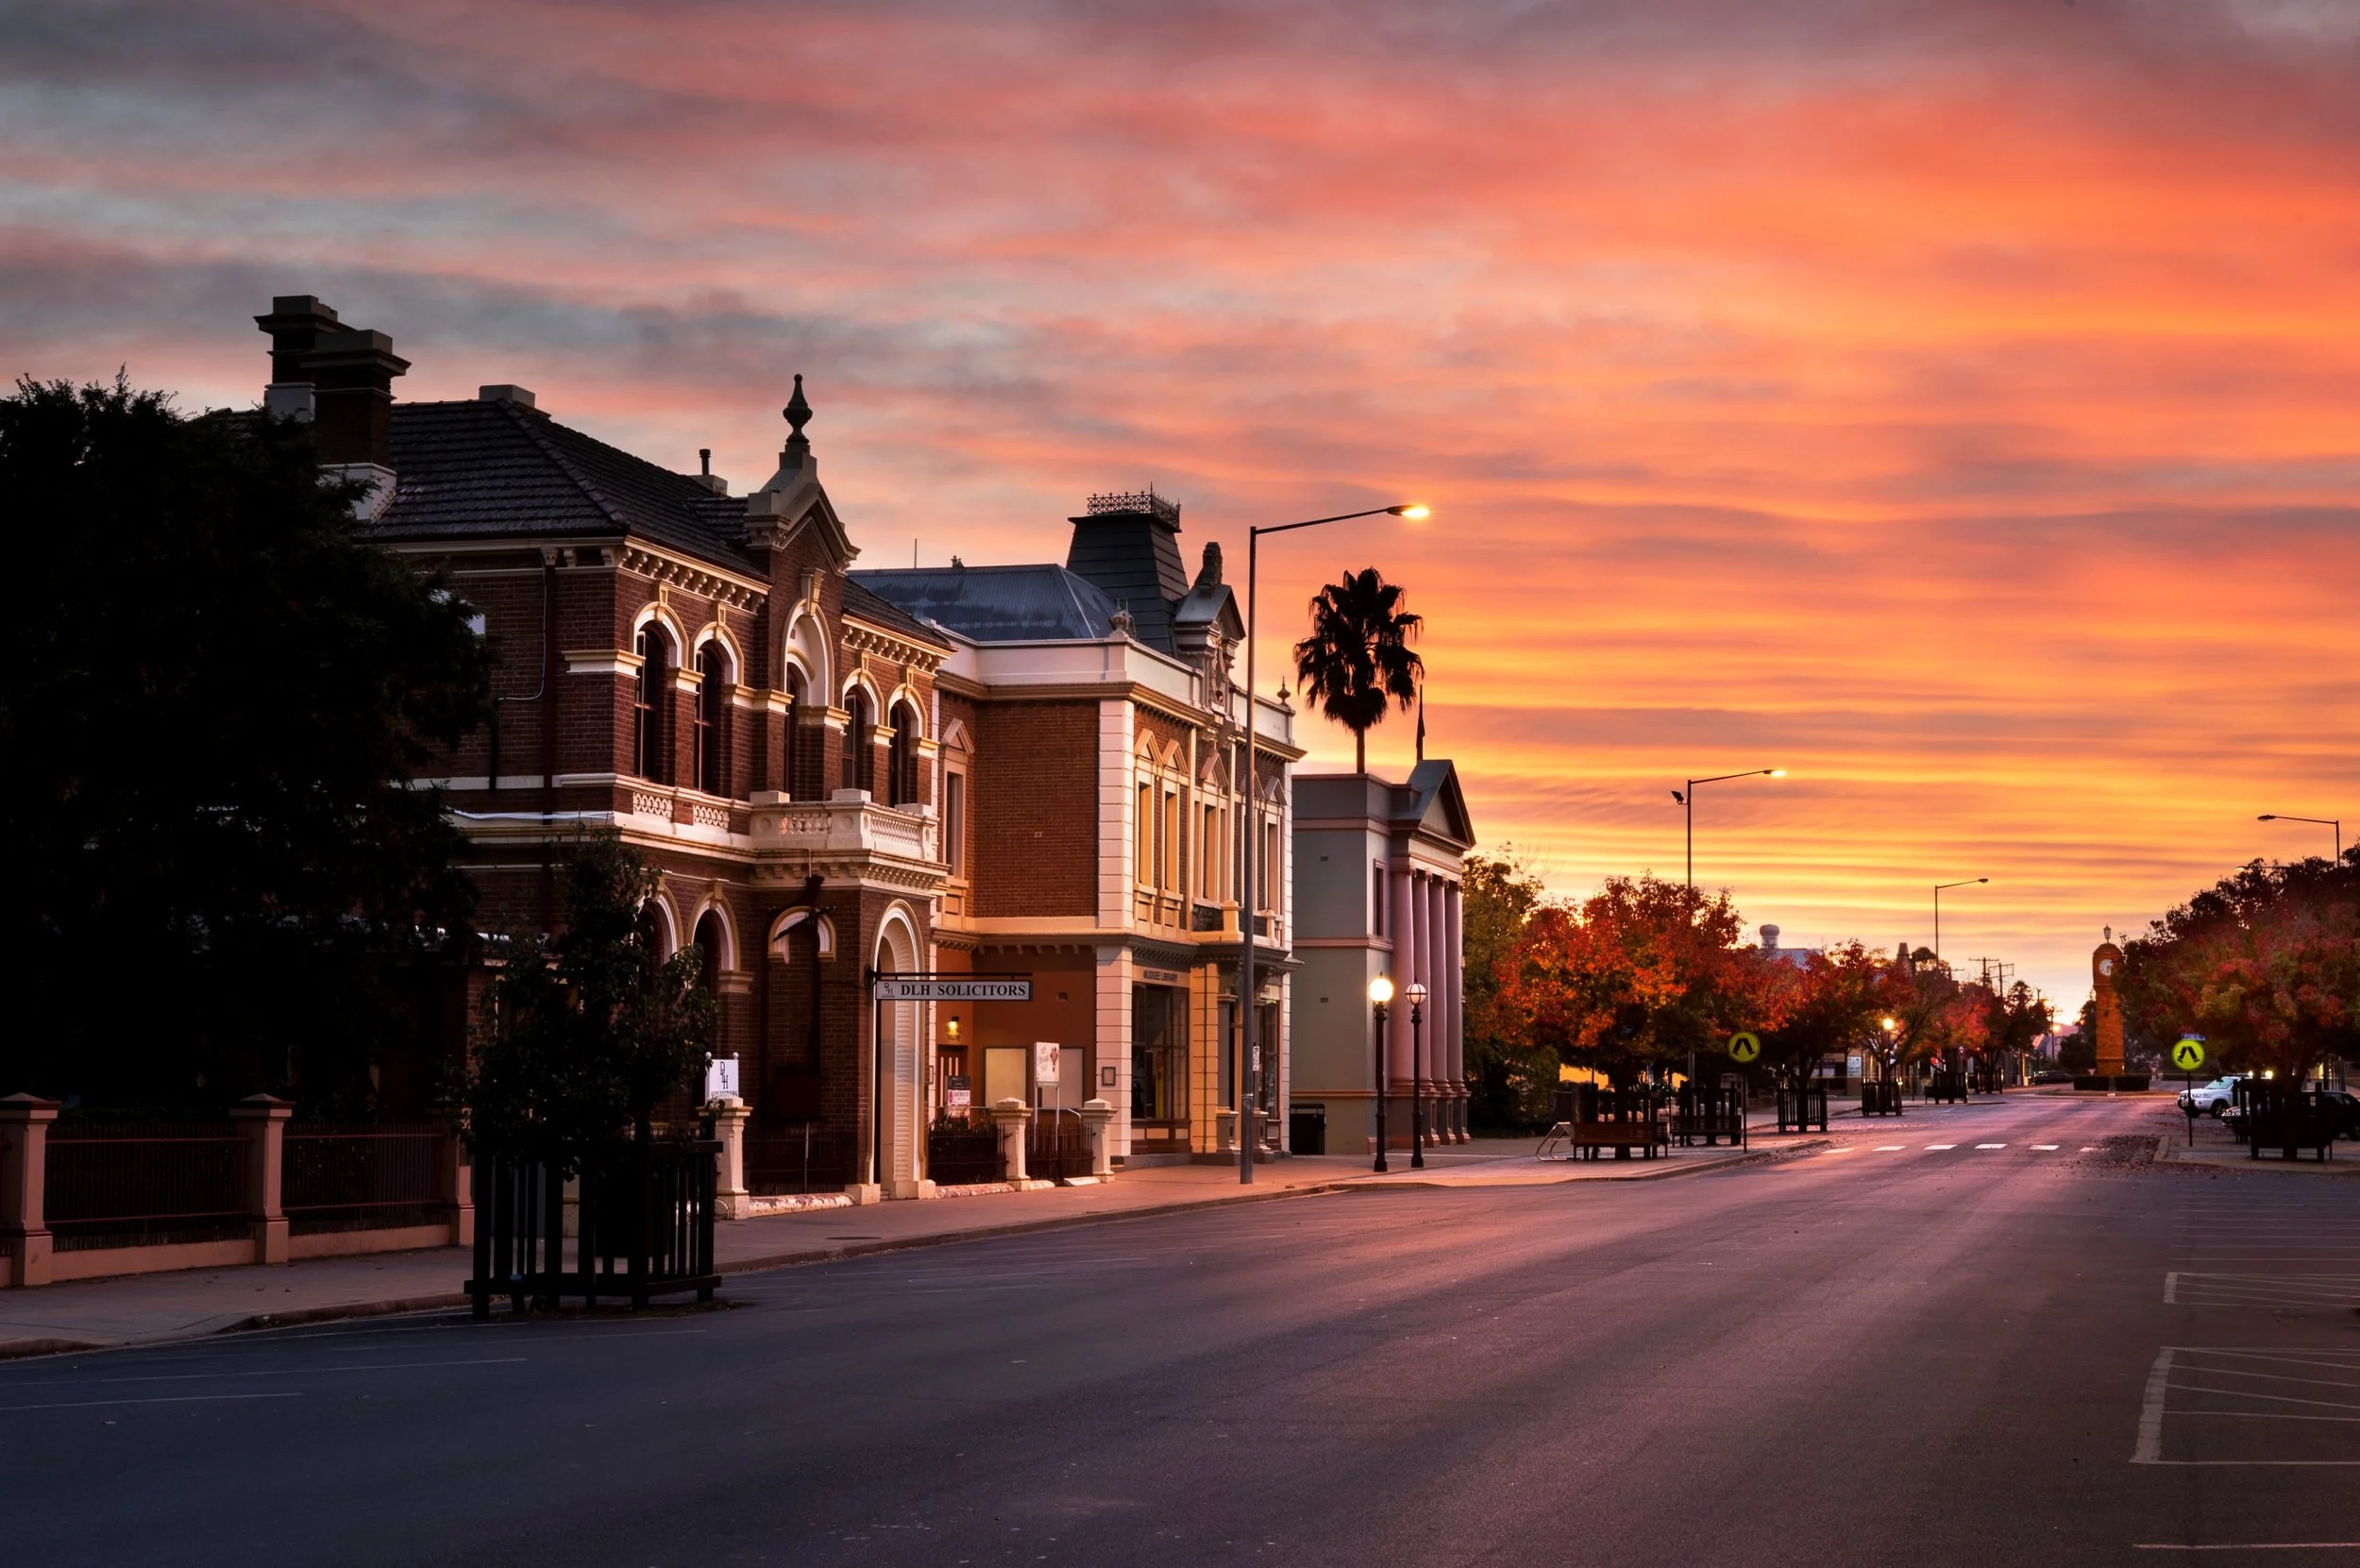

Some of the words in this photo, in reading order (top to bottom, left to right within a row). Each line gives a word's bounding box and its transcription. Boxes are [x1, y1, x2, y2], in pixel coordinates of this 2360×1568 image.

[1161, 971, 1178, 983] LIBRARY
[901, 984, 930, 996] DLH
[936, 984, 1026, 996] SOLICITORS
